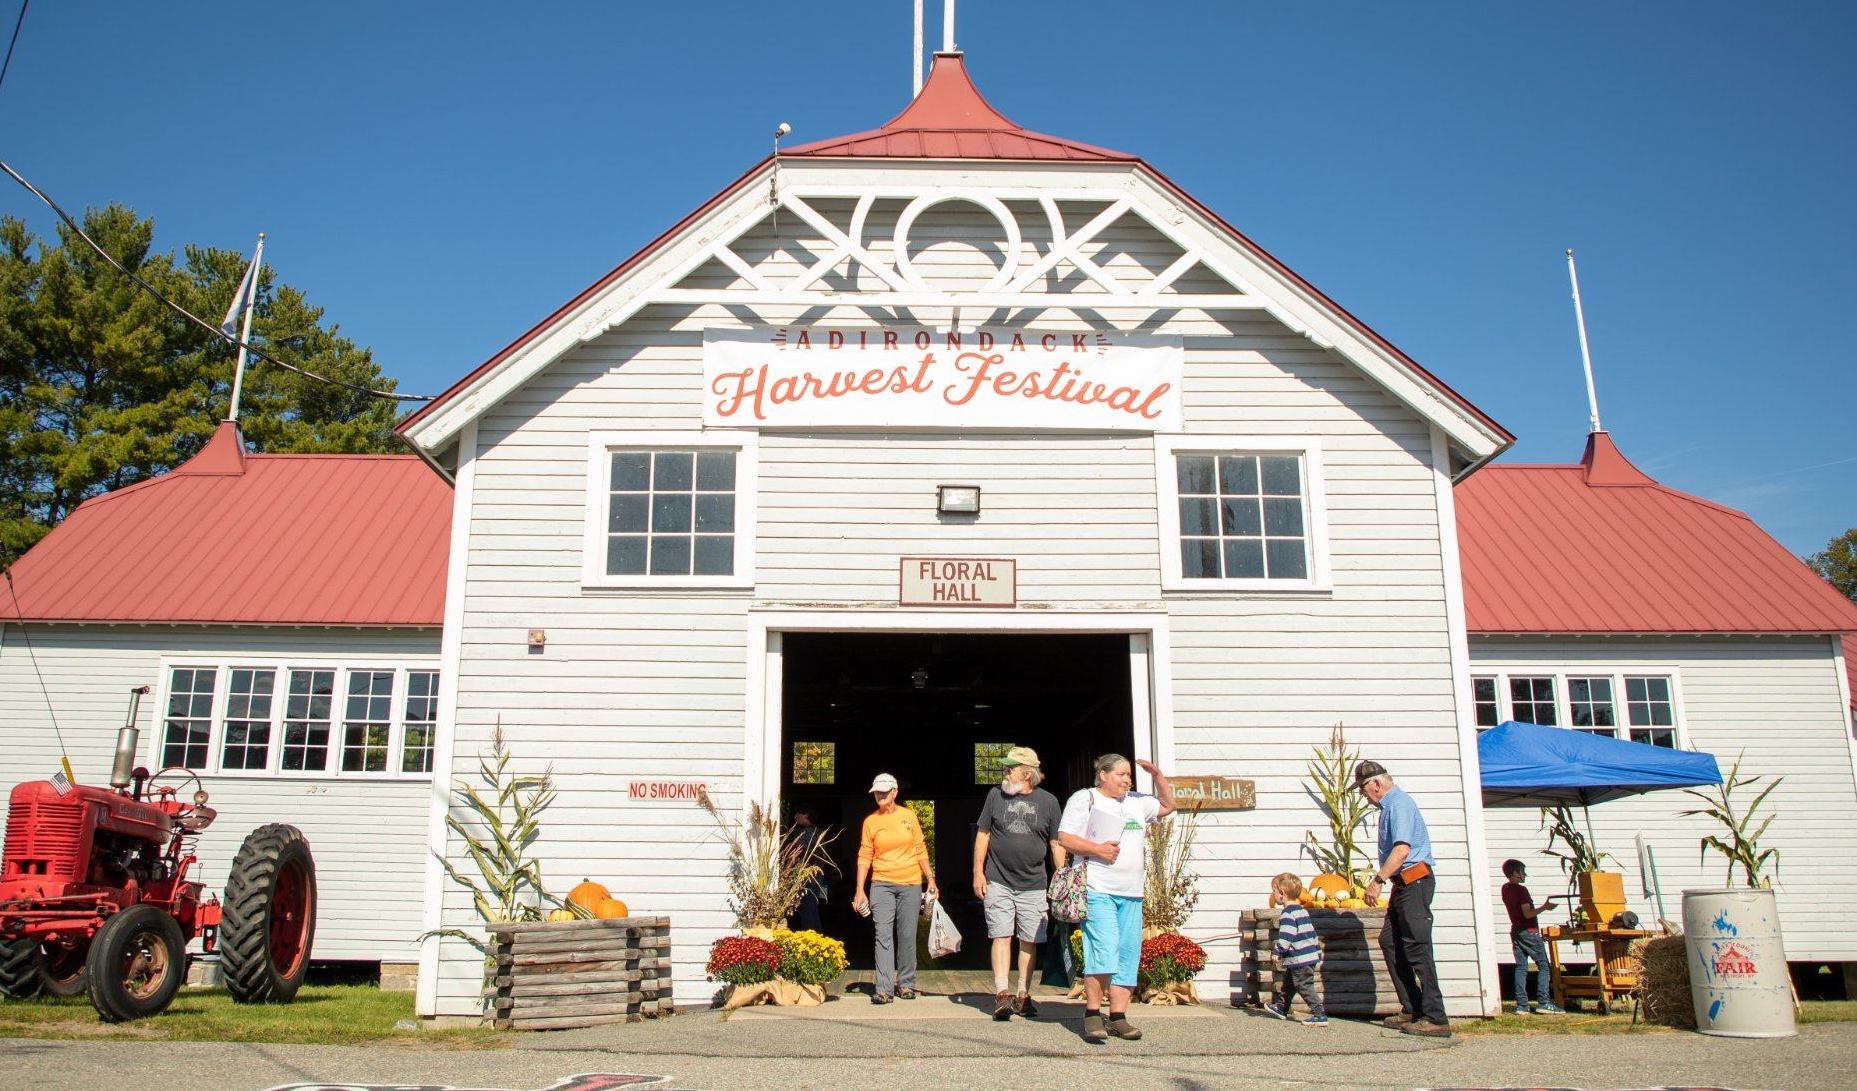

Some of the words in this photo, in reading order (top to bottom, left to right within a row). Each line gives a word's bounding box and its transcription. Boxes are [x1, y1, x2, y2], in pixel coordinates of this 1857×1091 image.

[796, 330, 1088, 352] ADIRONDACK
[711, 352, 937, 420] Harvest
[943, 352, 1171, 420] Festival
[919, 562, 997, 581] FLORAL
[933, 583, 982, 601] HALL
[629, 783, 647, 798] NO
[1169, 782, 1204, 799] loral
[1210, 780, 1240, 800] Hall
[1715, 962, 1758, 973] FAIR
